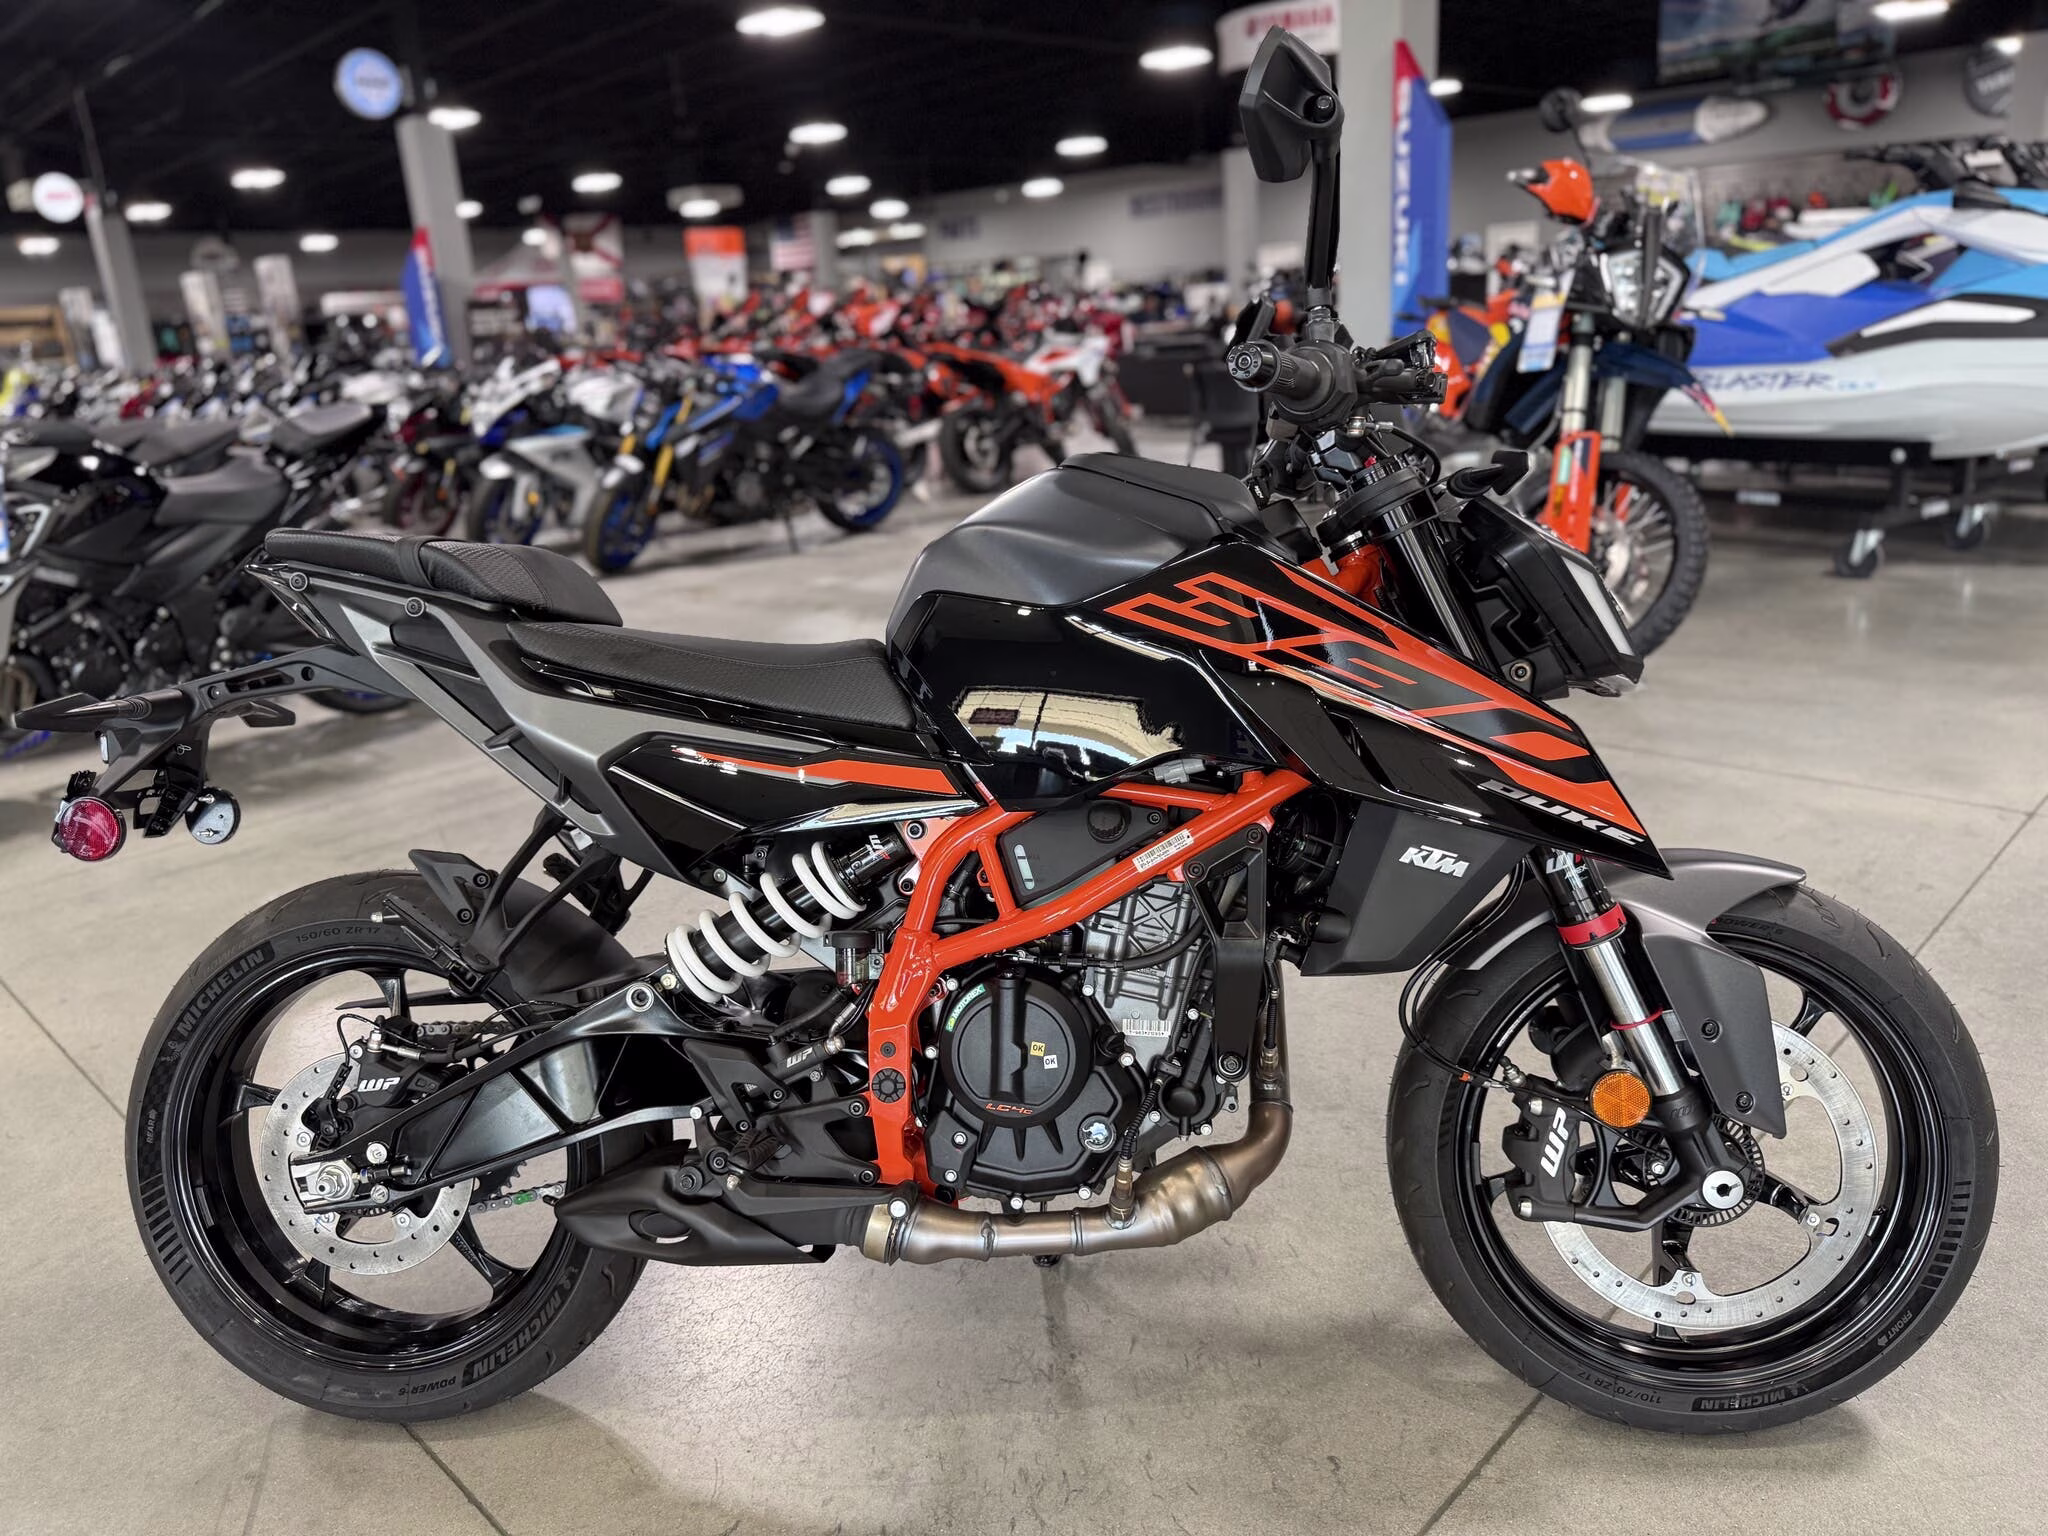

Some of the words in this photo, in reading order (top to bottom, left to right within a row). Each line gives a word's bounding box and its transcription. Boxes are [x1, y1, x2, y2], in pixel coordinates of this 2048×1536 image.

[1477, 779, 1646, 845] DUKE
[1398, 845, 1471, 878] KTM
[295, 927, 341, 943] 150/60
[346, 926, 362, 935] ZR
[367, 927, 381, 935] 17
[176, 949, 265, 1037] MICHELIN
[951, 986, 983, 1018] MOTOREX
[786, 1047, 813, 1069] WP
[1032, 1044, 1044, 1053] OK
[1044, 1057, 1056, 1066] OK
[357, 1077, 401, 1093] WP
[146, 1119, 156, 1144] REAR
[1540, 1106, 1569, 1178] WP
[472, 1291, 562, 1379] MICHELIN
[1887, 1310, 1913, 1339] FRONT
[410, 1375, 457, 1395] POWER
[1577, 1370, 1590, 1382] 17
[1593, 1376, 1613, 1393] ZR
[1616, 1385, 1663, 1404] 110/70
[1700, 1388, 1786, 1411] MICHELIN
